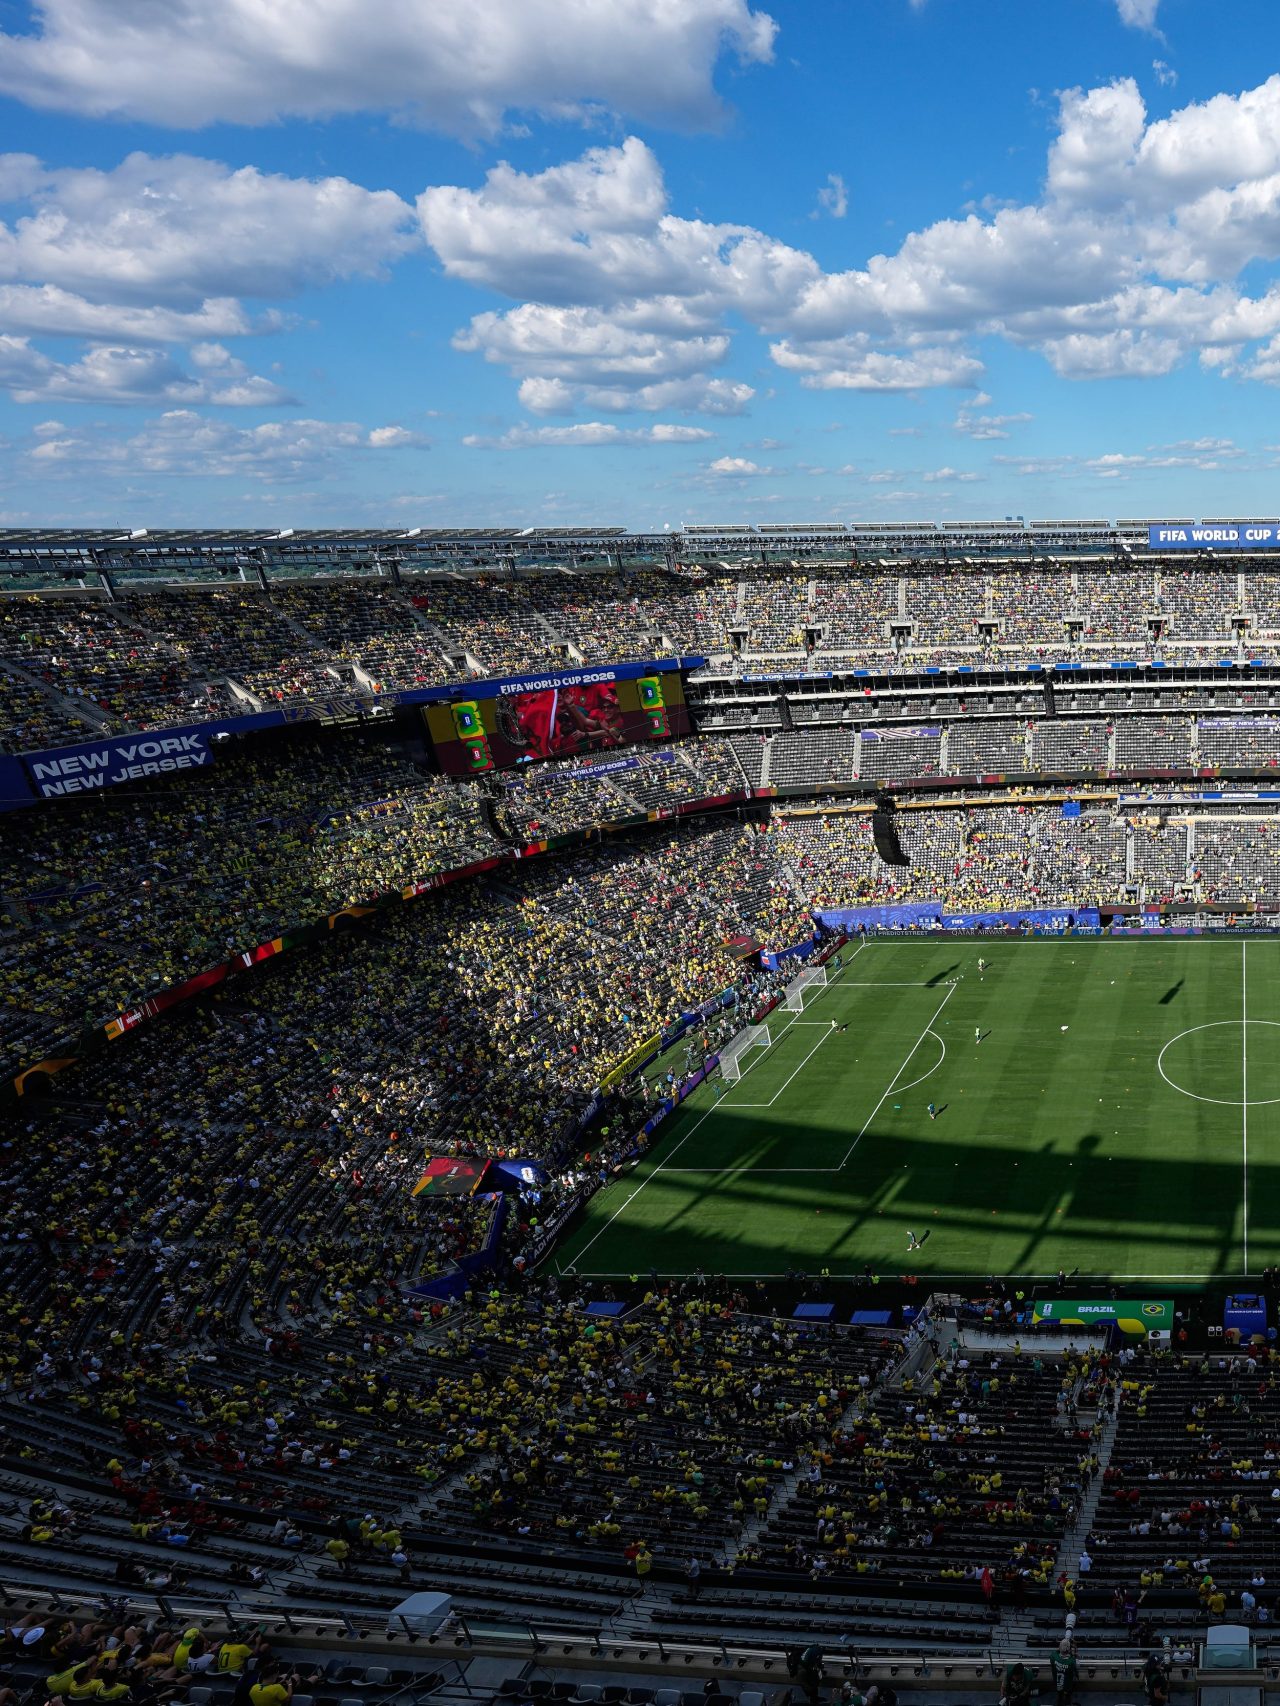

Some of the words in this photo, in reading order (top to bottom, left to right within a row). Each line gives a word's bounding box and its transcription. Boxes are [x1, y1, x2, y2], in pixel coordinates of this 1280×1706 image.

[1159, 530, 1187, 542] FIFA
[1192, 530, 1239, 541] WORLD
[1245, 529, 1271, 541] CUP
[500, 683, 523, 695] FIFA
[523, 679, 560, 691] WORLD
[562, 676, 582, 686] CUP
[583, 671, 616, 683] 2026
[32, 750, 109, 780] NEW
[115, 733, 204, 762] YORK
[41, 772, 104, 797] NEW
[112, 751, 207, 783] JERSEY
[571, 766, 593, 778] WORLD
[594, 764, 606, 773] CUP
[606, 760, 627, 770] 2026
[651, 1107, 667, 1127] VISA
[533, 1240, 547, 1259] ADI
